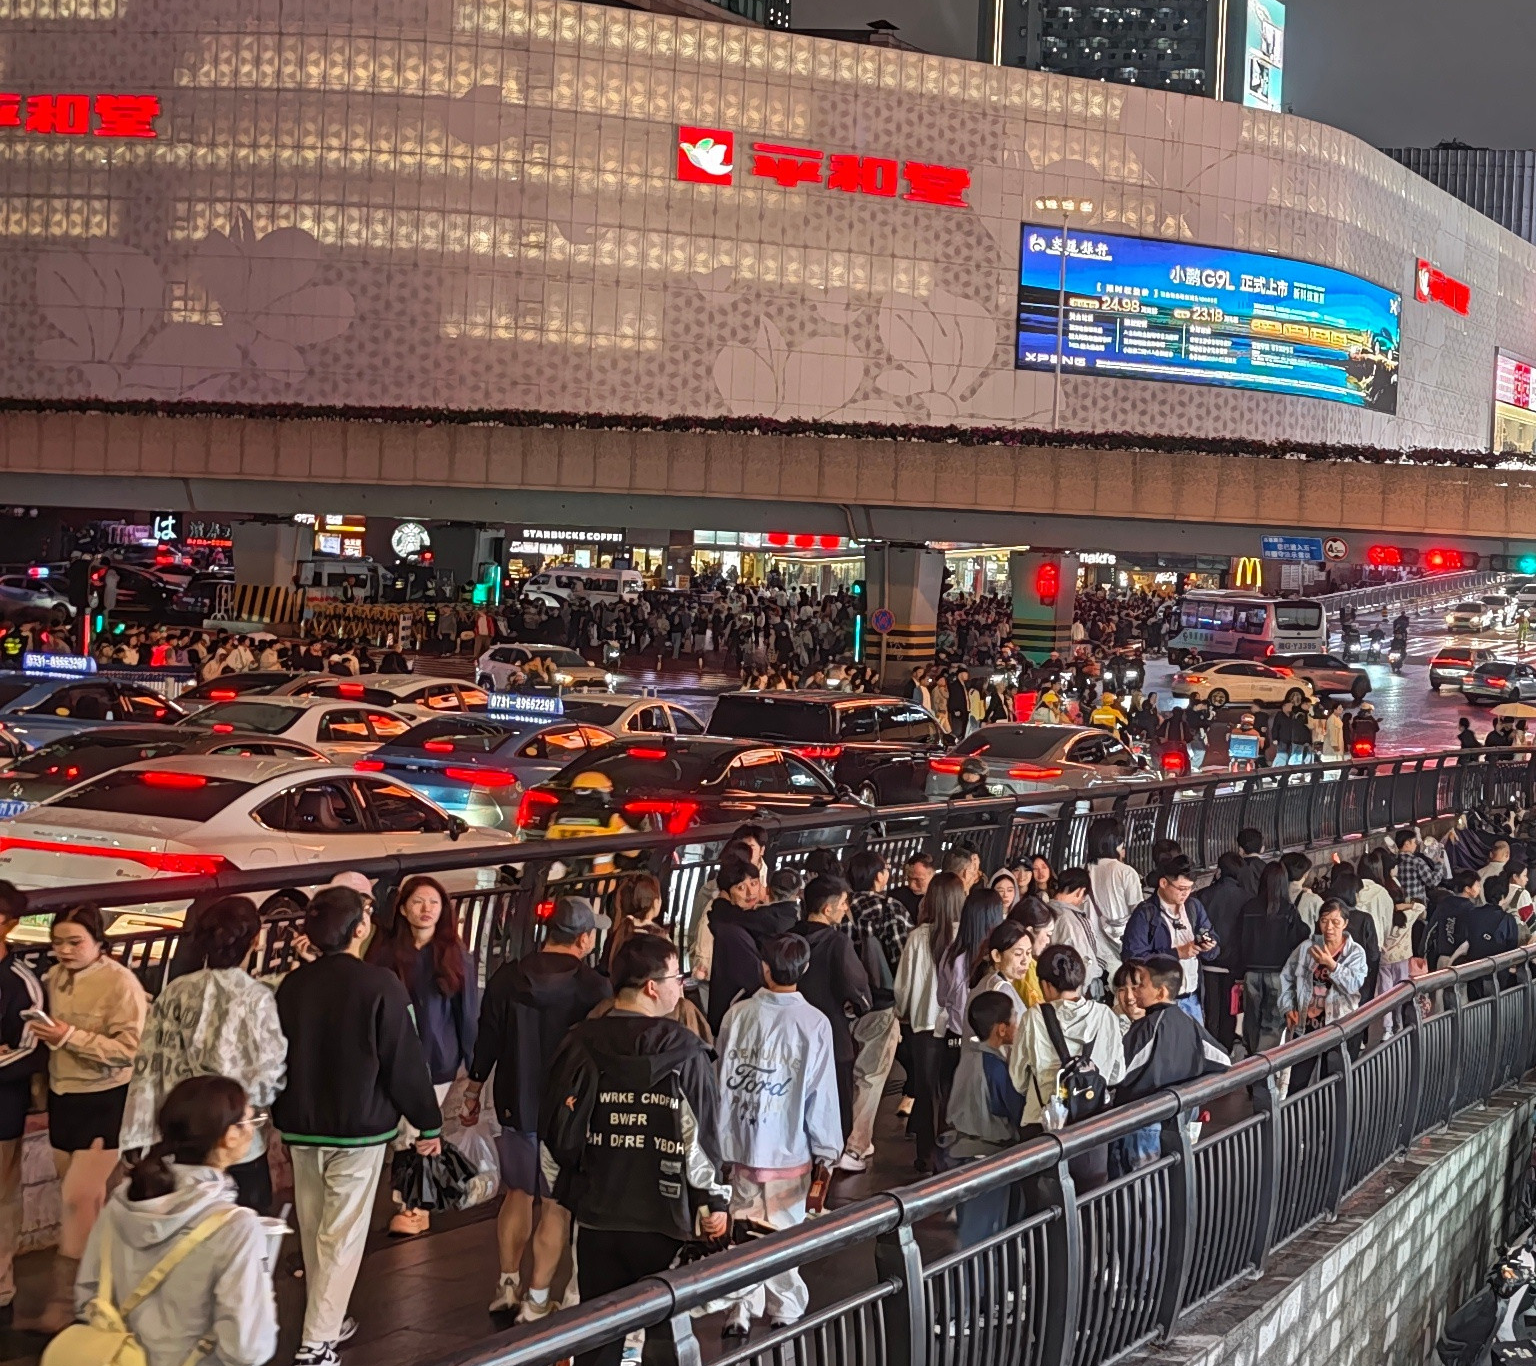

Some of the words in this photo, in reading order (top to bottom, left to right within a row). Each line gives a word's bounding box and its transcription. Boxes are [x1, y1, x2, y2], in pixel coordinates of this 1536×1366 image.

[752, 141, 970, 208] 平和堂
[1239, 274, 1289, 298] 正式上市
[1101, 296, 1140, 313] 24.98
[1192, 306, 1223, 323] 23.18
[523, 529, 586, 540] STARBUCKS
[726, 1063, 793, 1097] Ford
[599, 1091, 635, 1104] WRKE
